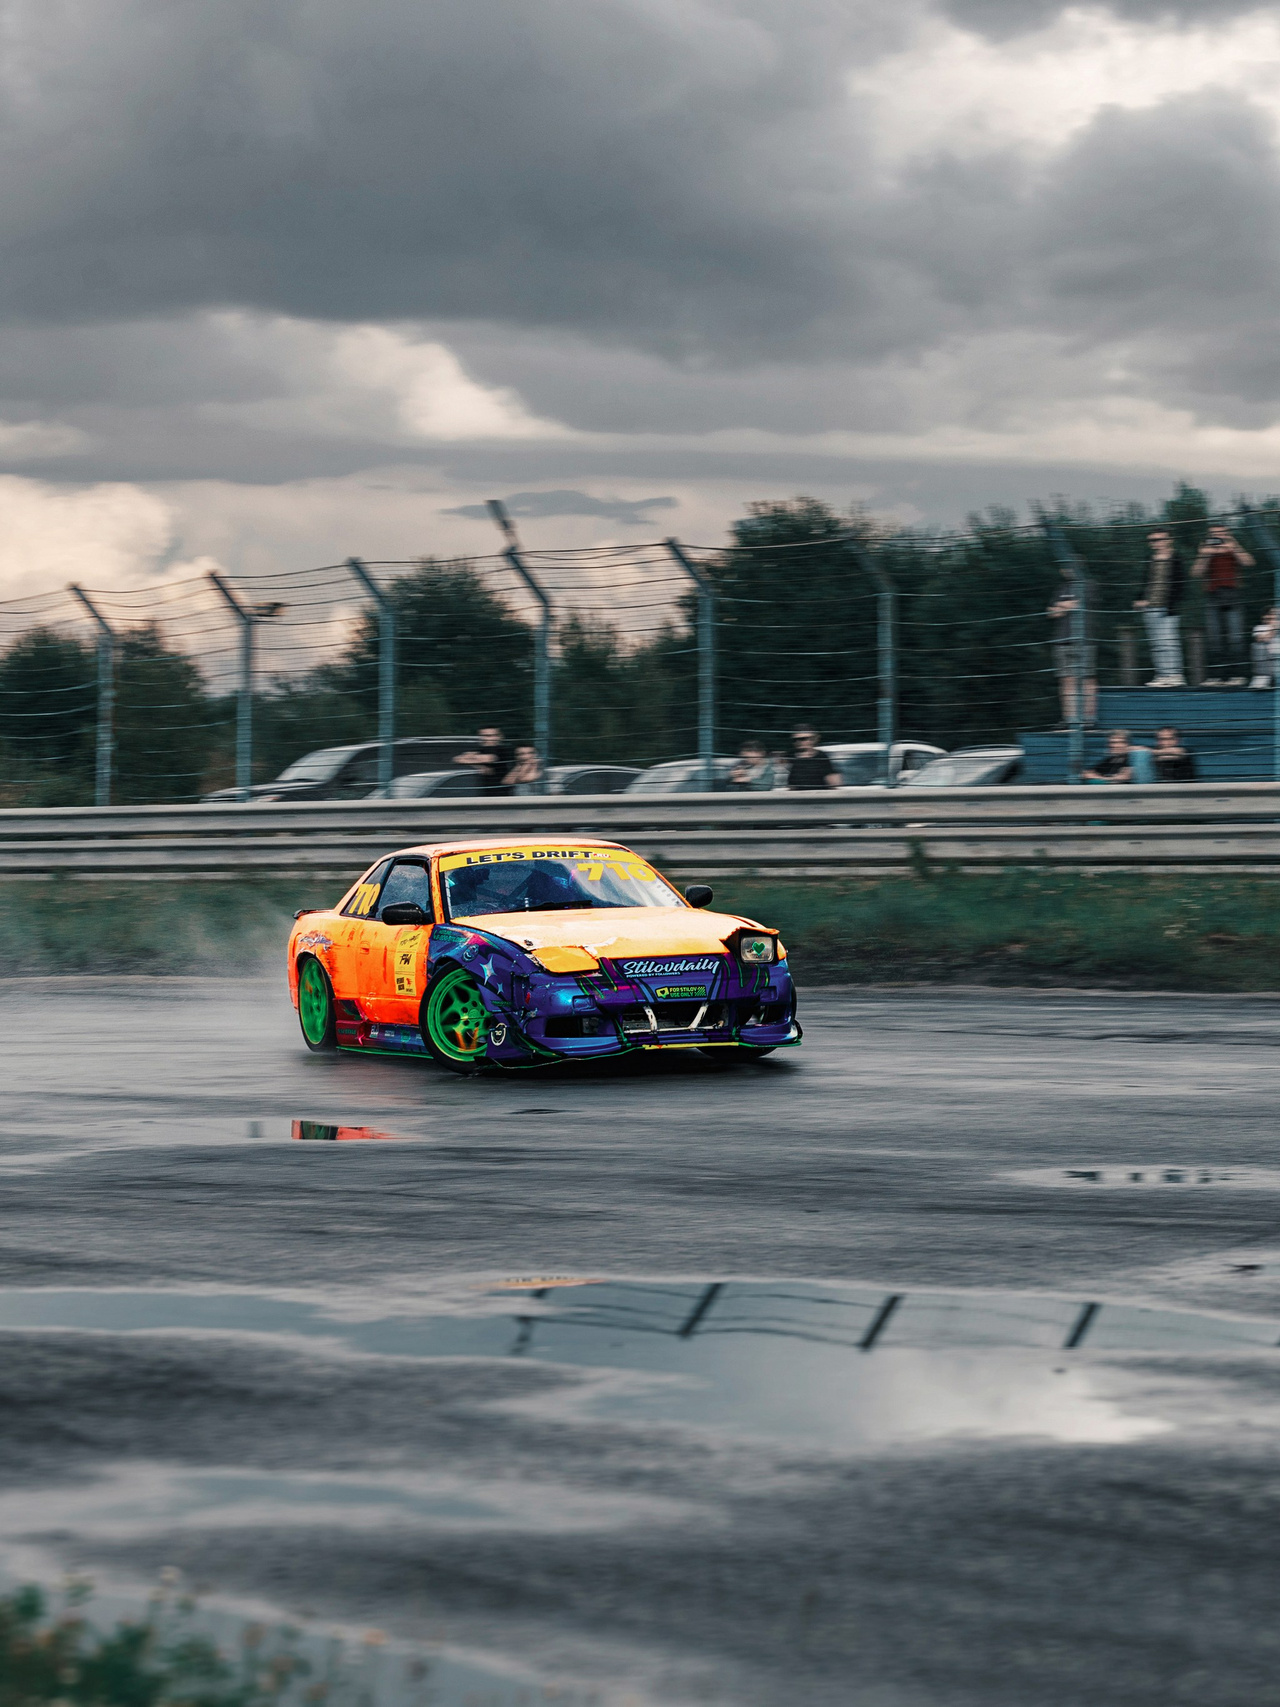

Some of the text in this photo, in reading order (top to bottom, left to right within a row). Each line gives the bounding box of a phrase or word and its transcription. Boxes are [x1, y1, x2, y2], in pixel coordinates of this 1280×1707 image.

[466, 851, 525, 866] LET'S
[577, 862, 657, 883] 710
[348, 882, 381, 916] 710
[623, 958, 720, 975] Stilovdaily
